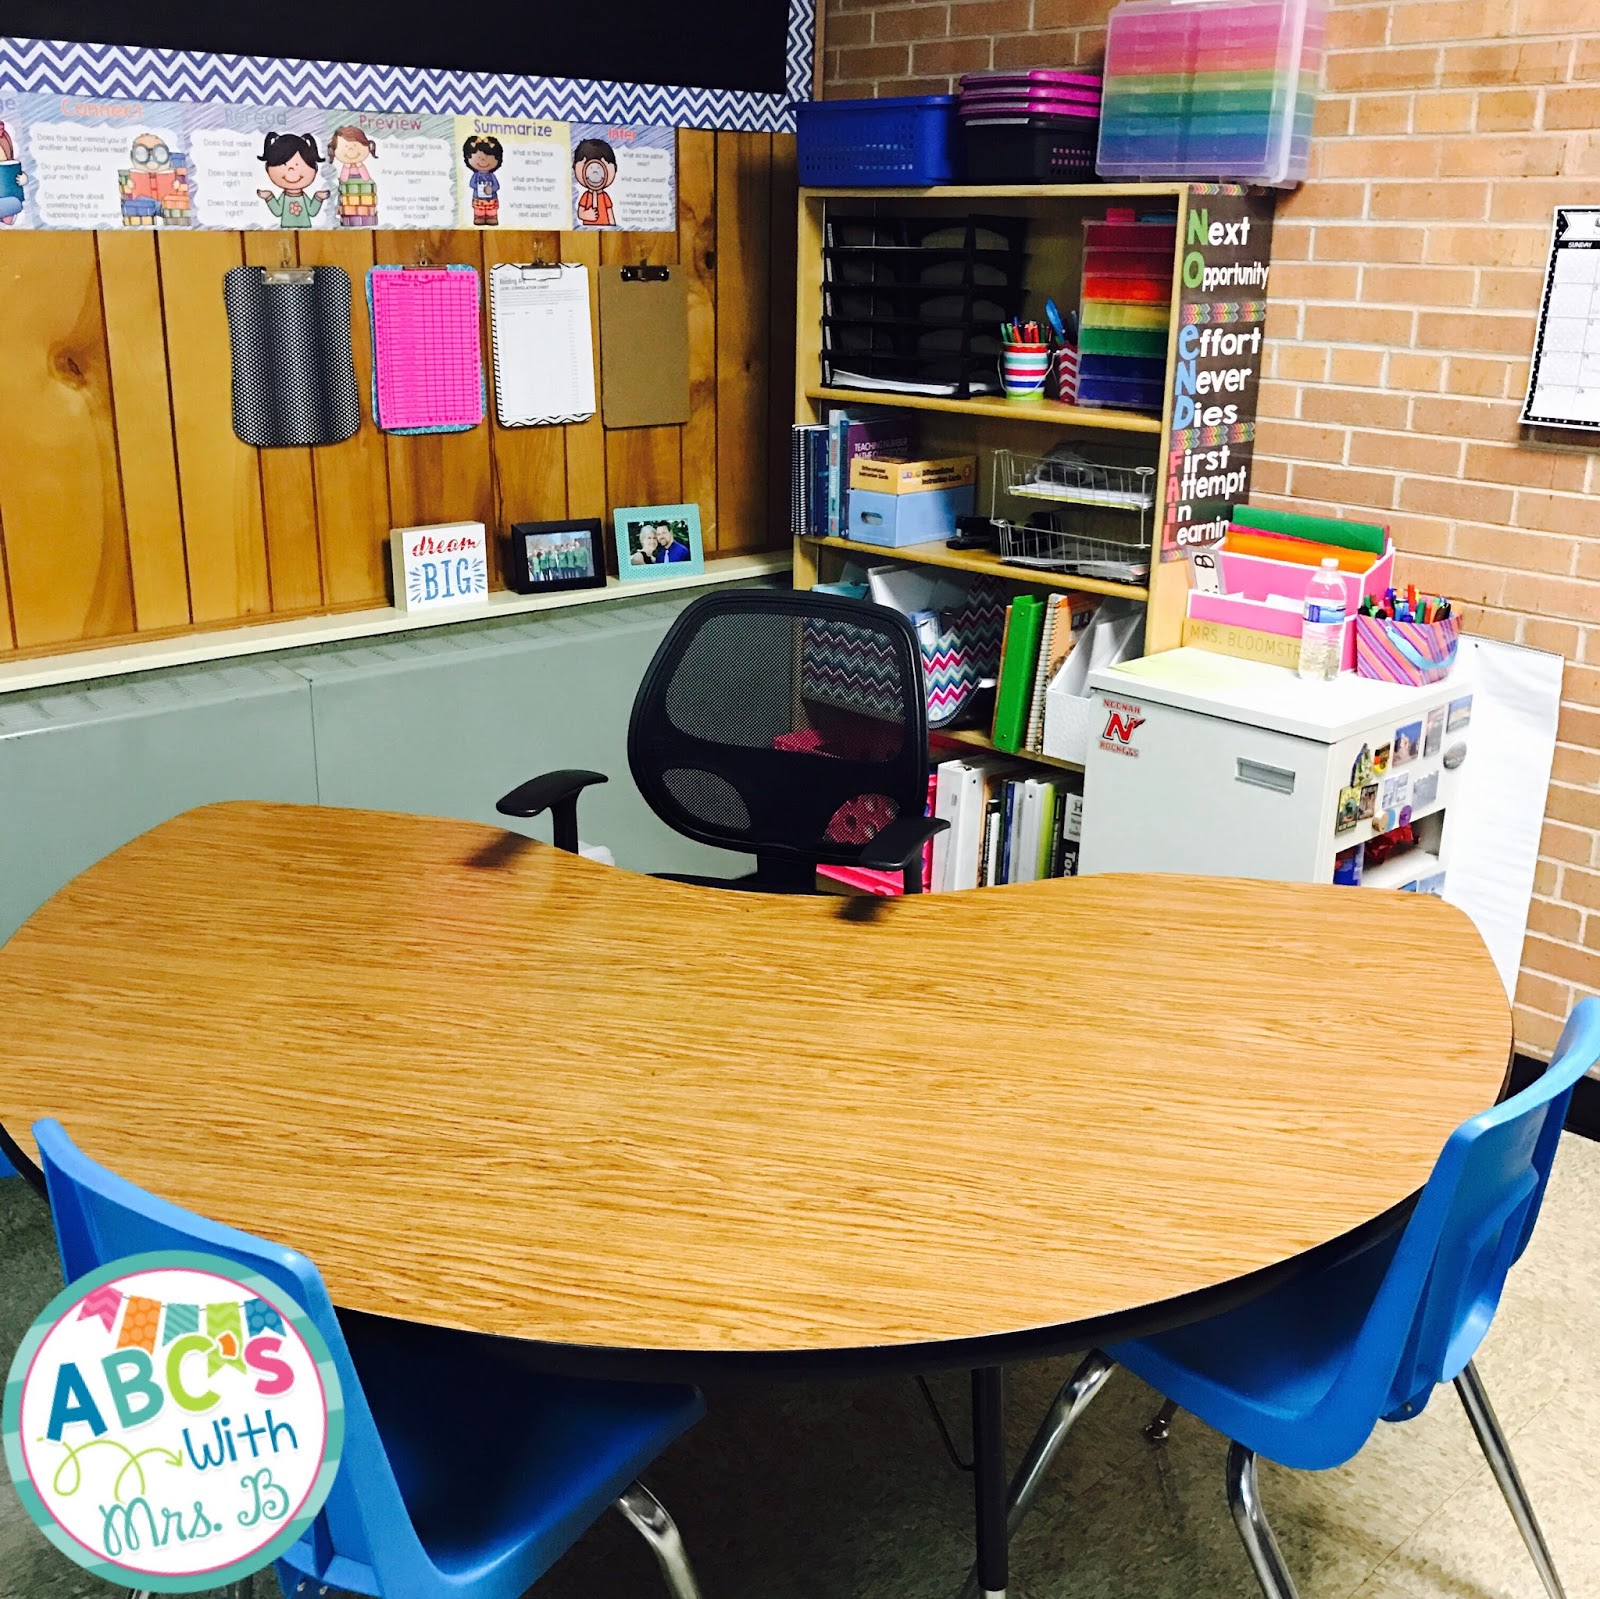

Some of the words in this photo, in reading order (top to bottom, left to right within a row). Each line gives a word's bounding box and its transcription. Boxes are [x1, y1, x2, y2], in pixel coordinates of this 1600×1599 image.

[61, 96, 143, 118] Connect
[225, 108, 287, 125] Reread
[358, 114, 422, 131] Preview
[474, 118, 552, 137] Summarize
[608, 127, 638, 142] Infer
[1187, 208, 1250, 246] Next
[1568, 241, 1593, 249] SUNDAY
[1183, 251, 1269, 292] Opportunity
[1179, 324, 1261, 361] effort
[1175, 360, 1252, 396] Never
[1172, 394, 1238, 430] Dies
[1169, 445, 1231, 475] First
[1166, 465, 1247, 503] Attempt
[412, 536, 481, 557] dream
[1162, 515, 1230, 550] Learnin
[422, 557, 471, 601] BIG
[1190, 624, 1222, 645] MRS.
[1228, 632, 1301, 658] BLOOMSTR
